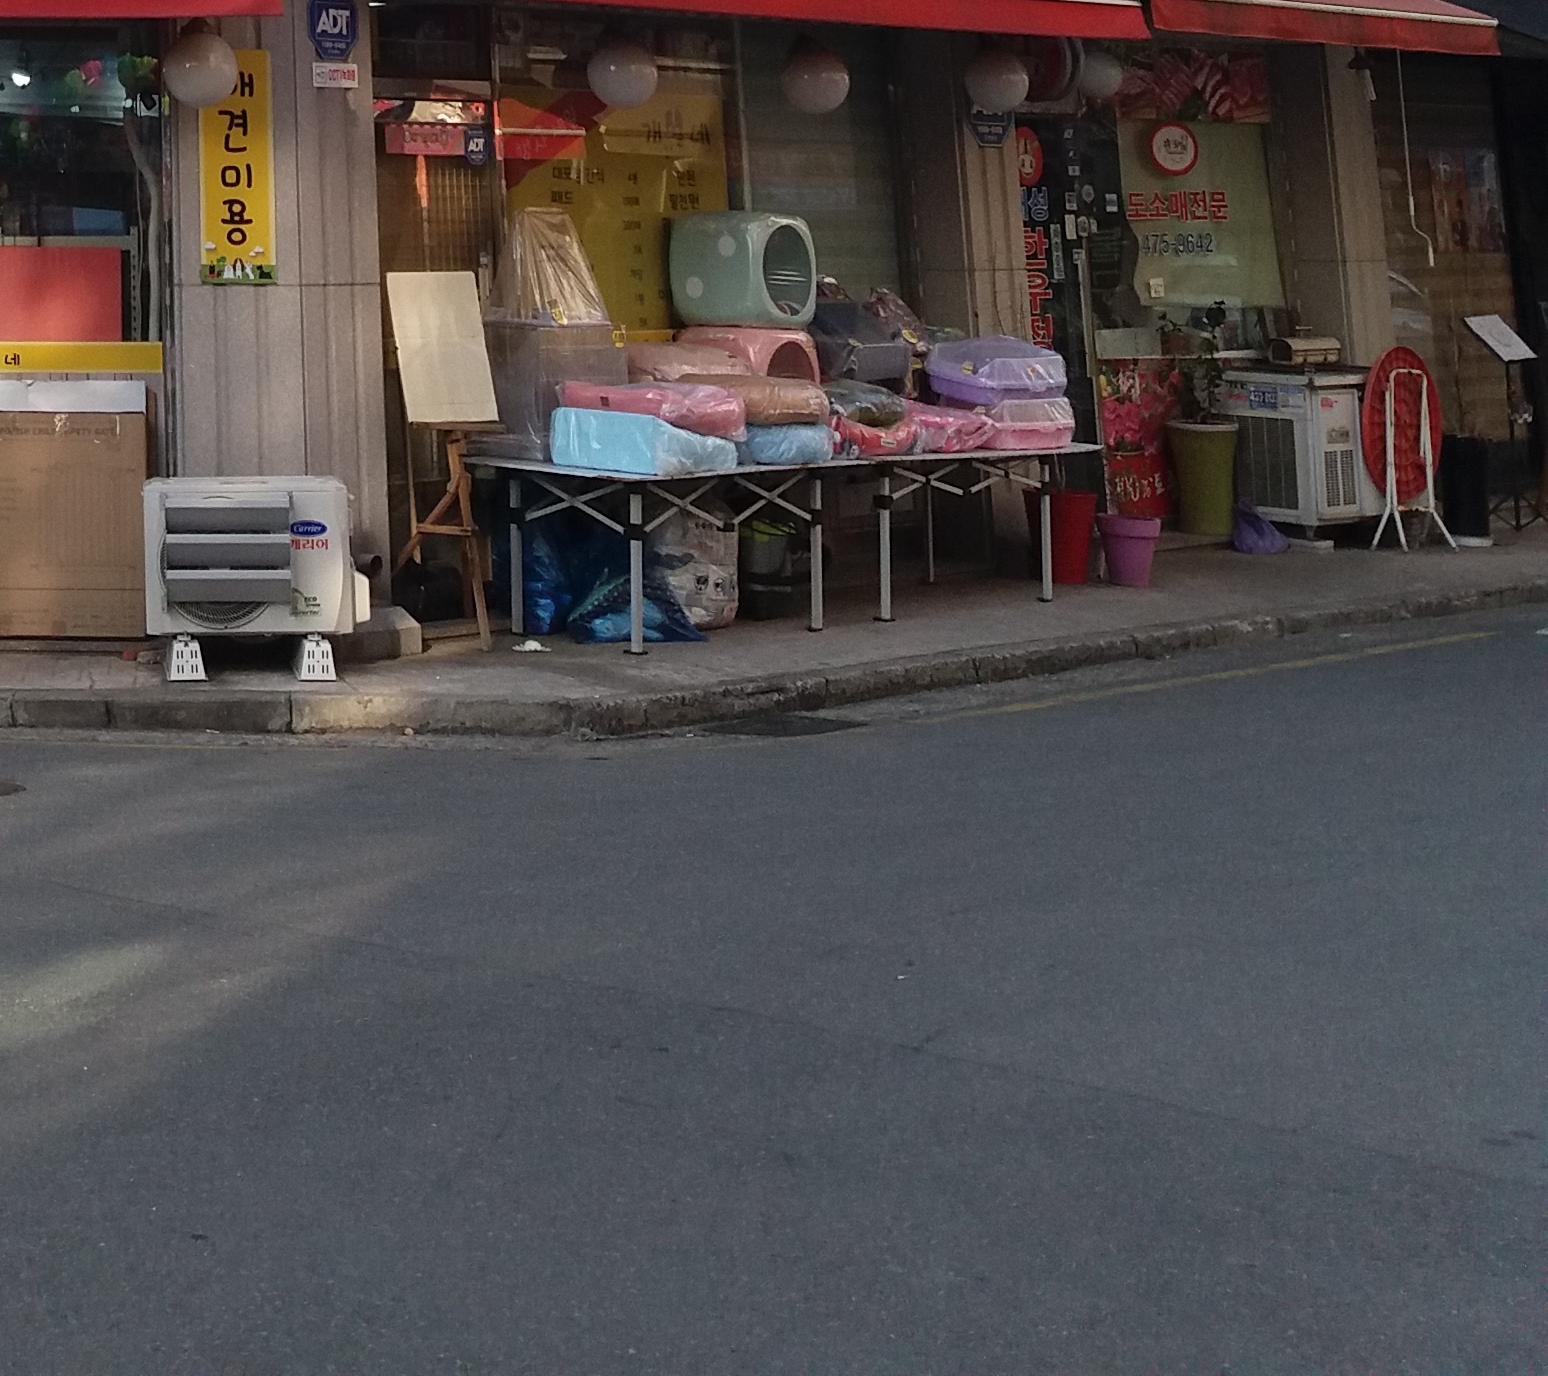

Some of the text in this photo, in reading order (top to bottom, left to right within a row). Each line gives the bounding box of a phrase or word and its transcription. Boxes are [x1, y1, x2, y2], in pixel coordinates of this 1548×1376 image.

[316, 8, 351, 36] ADT
[467, 137, 485, 152] ADT
[1127, 189, 1229, 221] 도소매전문
[1142, 232, 1214, 256] 475-9642
[293, 523, 323, 533] Carrier
